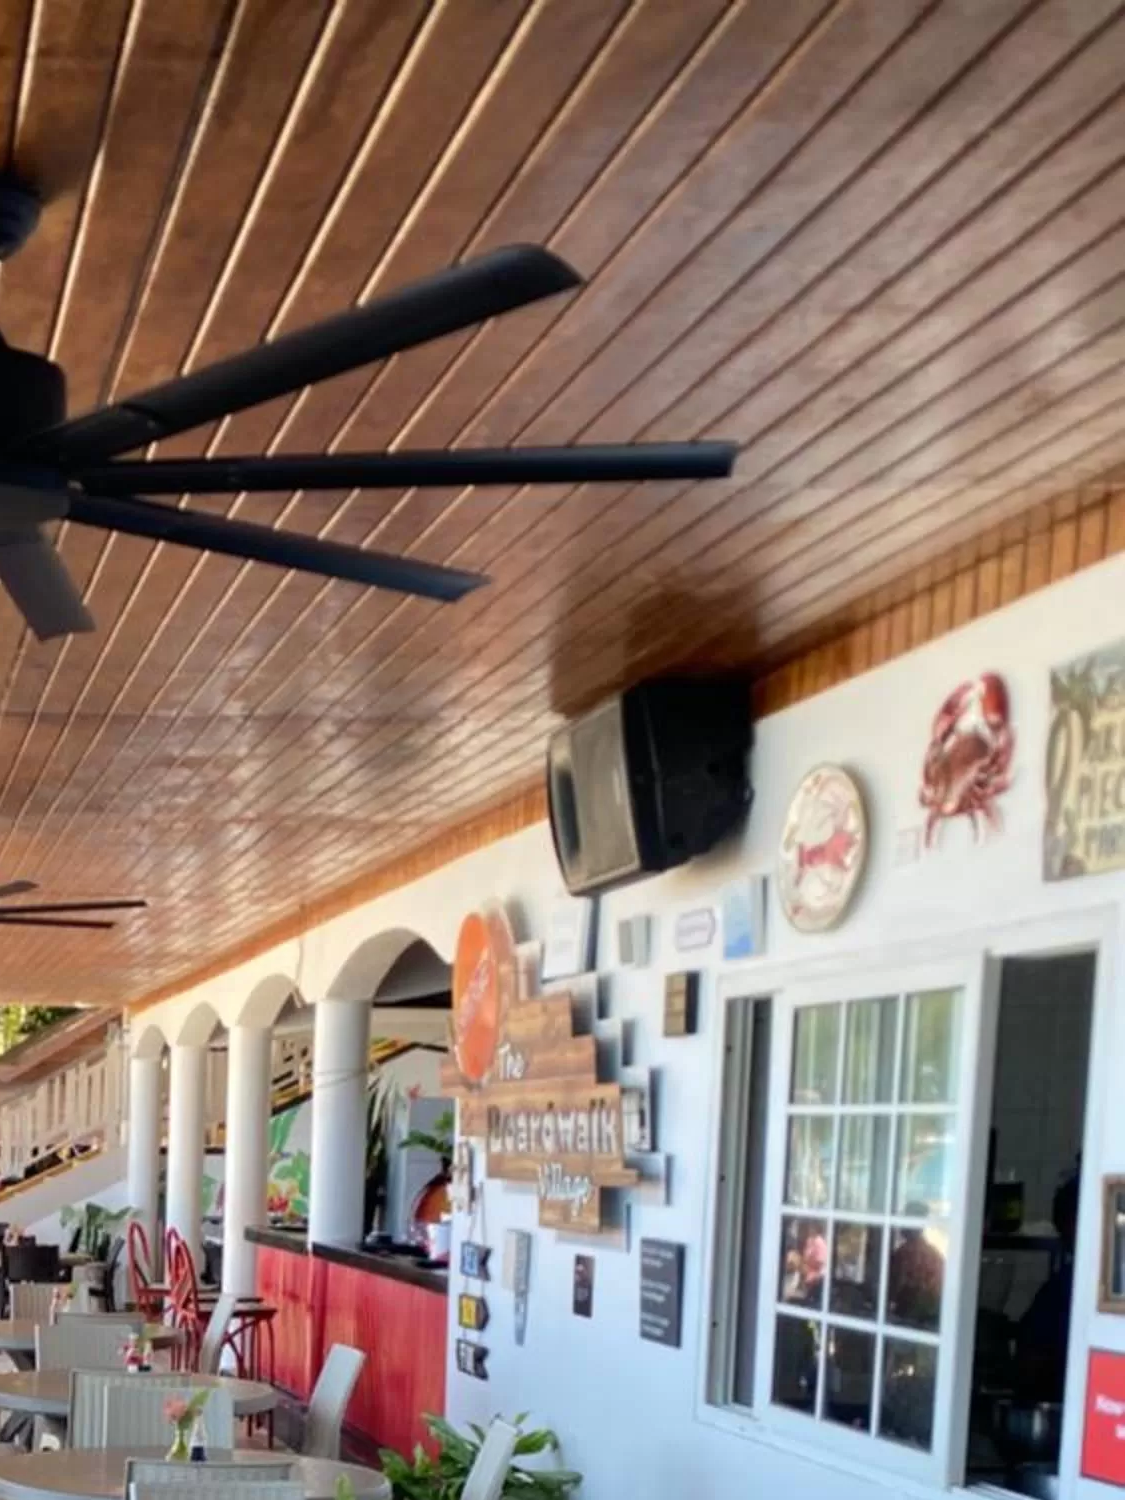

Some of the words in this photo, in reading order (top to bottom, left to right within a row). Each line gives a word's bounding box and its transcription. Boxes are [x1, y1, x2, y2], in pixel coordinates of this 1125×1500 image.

[498, 1042, 524, 1080] The
[486, 1098, 618, 1154] Boardwalk
[537, 1162, 592, 1216] Village
